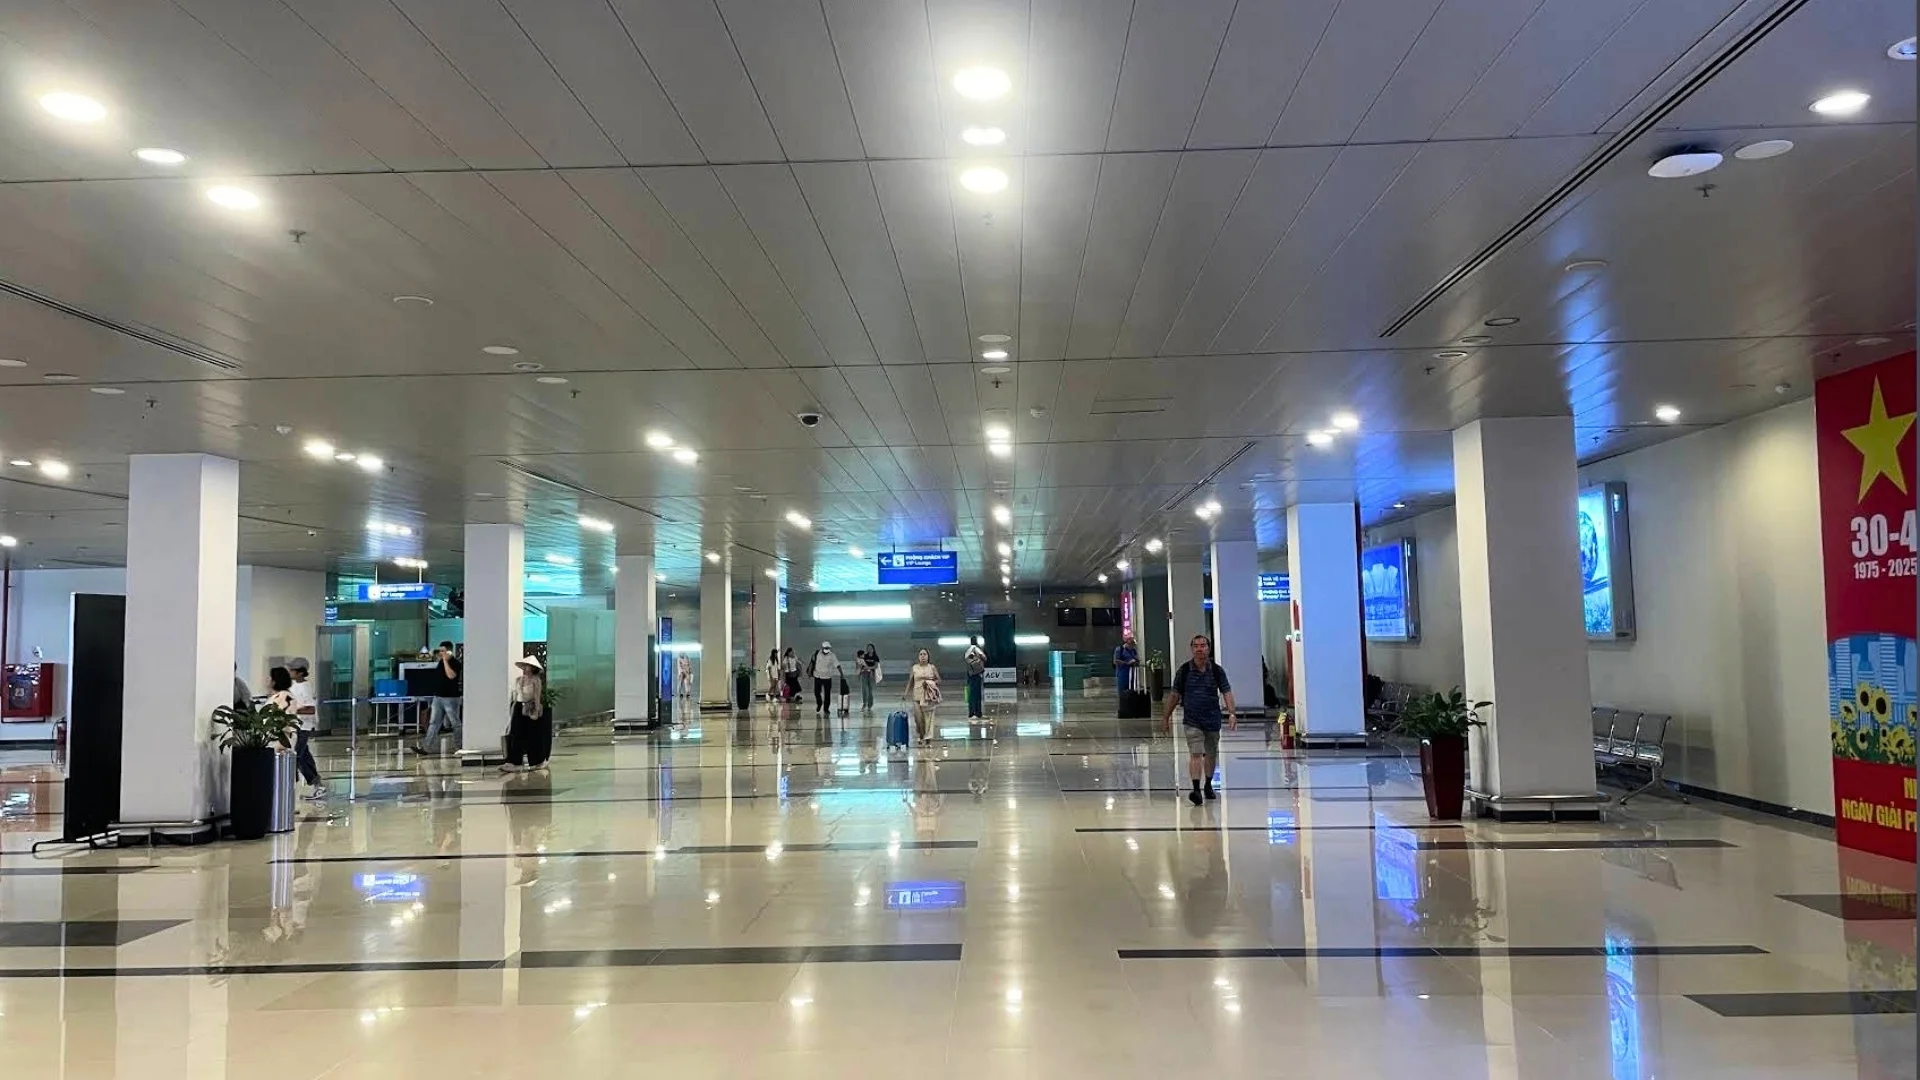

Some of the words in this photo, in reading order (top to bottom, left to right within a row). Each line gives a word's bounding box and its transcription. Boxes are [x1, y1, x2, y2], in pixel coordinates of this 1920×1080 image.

[1851, 509, 1917, 558] 30-4
[1853, 560, 1880, 579] 1975
[1888, 557, 1917, 577] 2025
[985, 671, 1000, 679] ACV
[1842, 797, 1873, 823] NGÀY
[1876, 801, 1902, 829] GIẢI
